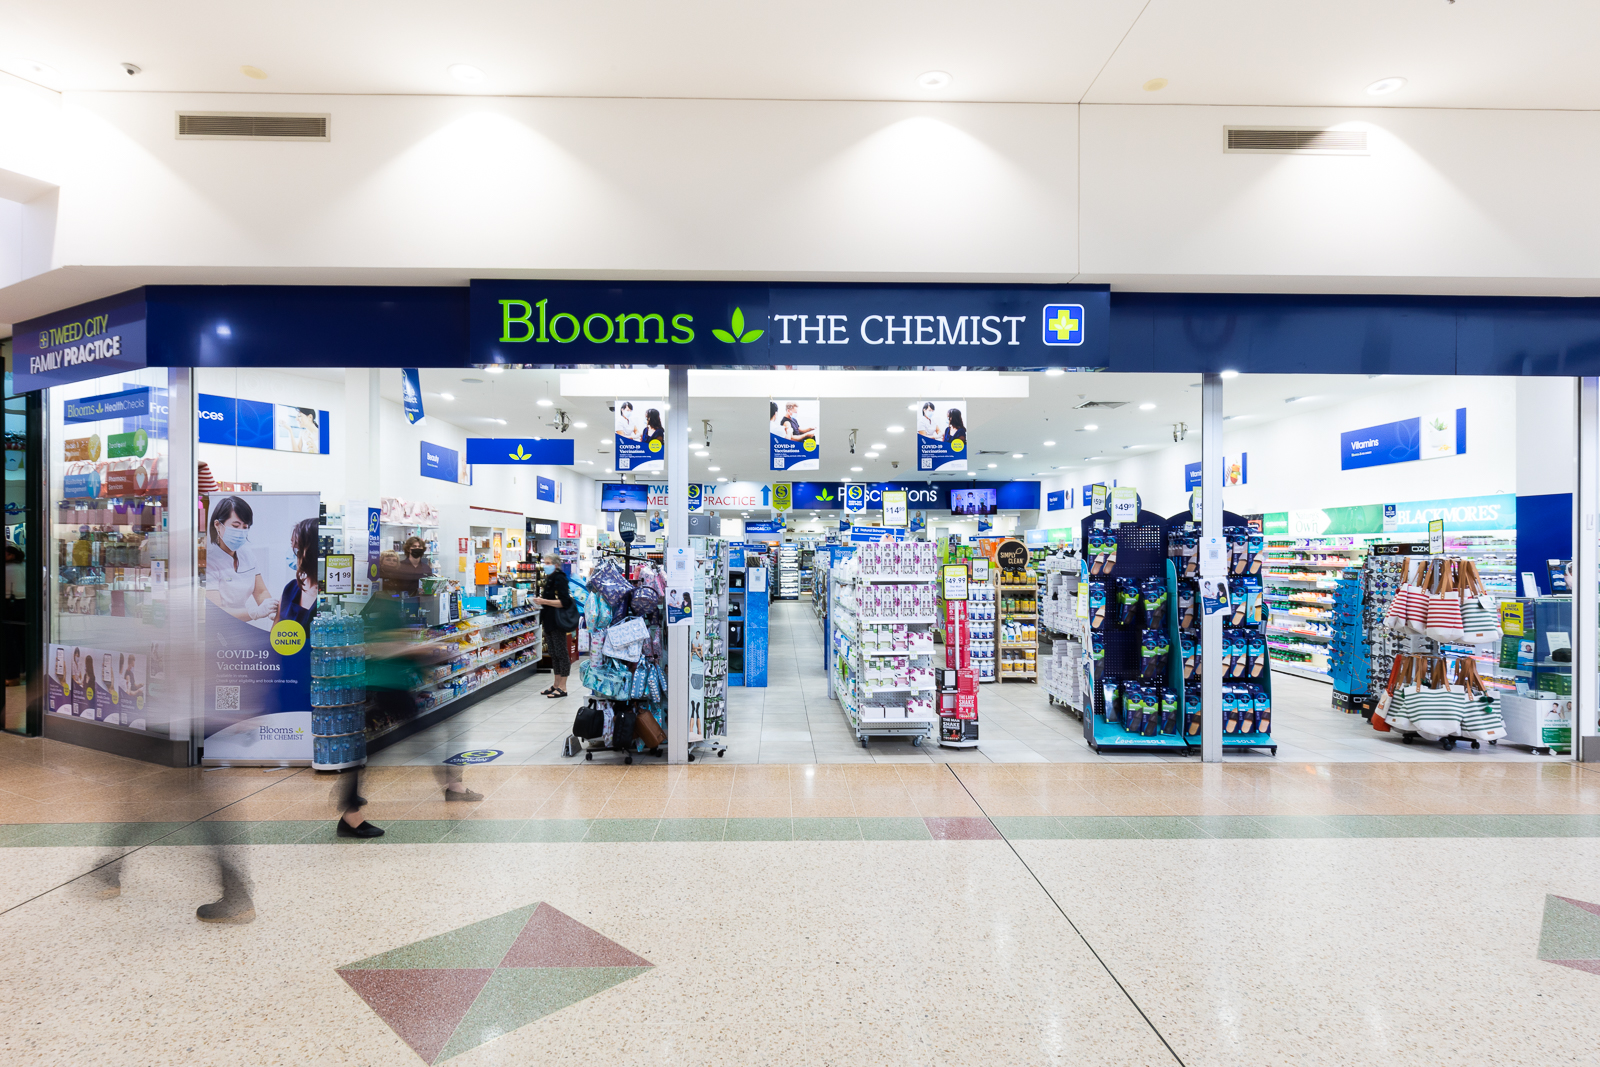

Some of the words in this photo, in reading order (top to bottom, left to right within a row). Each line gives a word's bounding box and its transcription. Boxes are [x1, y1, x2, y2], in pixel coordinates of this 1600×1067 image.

[499, 298, 694, 344] Blooms
[774, 314, 850, 345] THE
[860, 314, 1026, 346] CHEMIST
[49, 322, 83, 346] TWEED
[84, 314, 108, 337] CITY
[30, 350, 63, 374] FAMILY
[64, 336, 120, 367] PRACTICE
[68, 404, 95, 418] Blooms
[1350, 439, 1379, 450] Vitamins
[426, 452, 440, 464] Beauty
[1396, 504, 1498, 524] BLACKMORES
[1296, 520, 1319, 534] Own
[216, 650, 269, 659] COVID-19
[216, 662, 280, 671] Vaccinations
